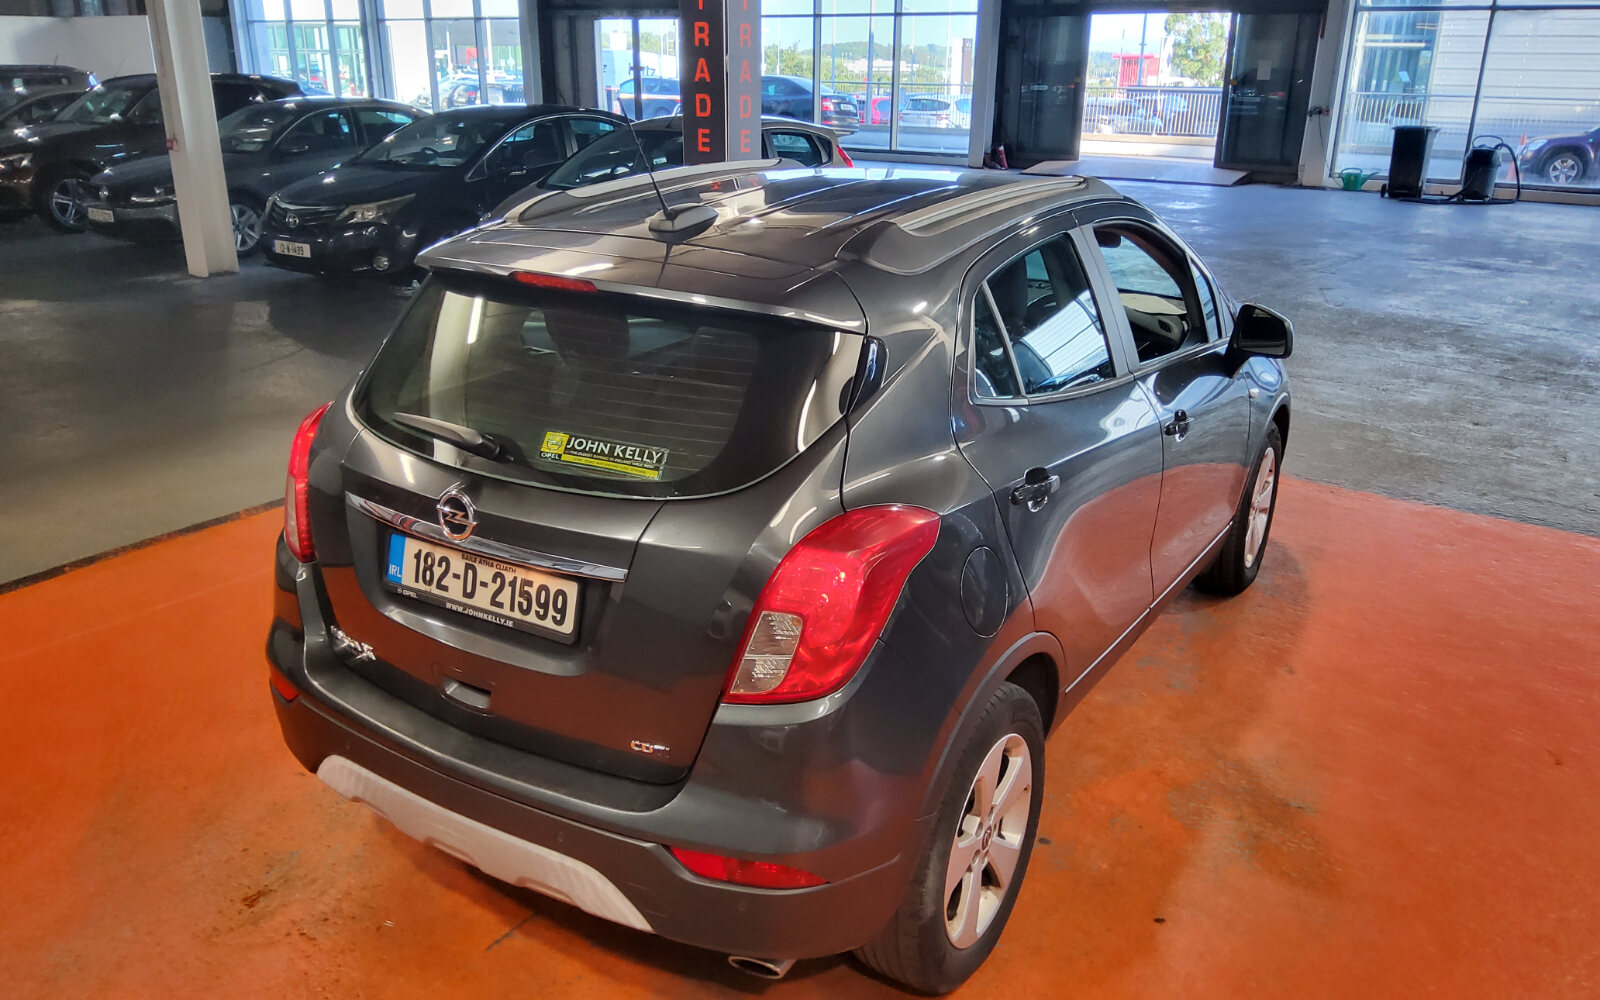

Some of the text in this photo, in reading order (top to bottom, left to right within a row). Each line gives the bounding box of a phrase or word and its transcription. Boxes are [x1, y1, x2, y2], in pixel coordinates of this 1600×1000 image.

[541, 452, 560, 460] OPEL
[566, 437, 611, 455] JOHN
[613, 445, 663, 464] KELLY
[388, 563, 403, 578] IRL
[461, 553, 477, 563] BAILE
[495, 563, 517, 574] CLIATH
[402, 589, 418, 599] OPEL
[413, 548, 568, 627] 182-D-21599
[445, 601, 514, 628] WWW.JOHNKELLY.IE
